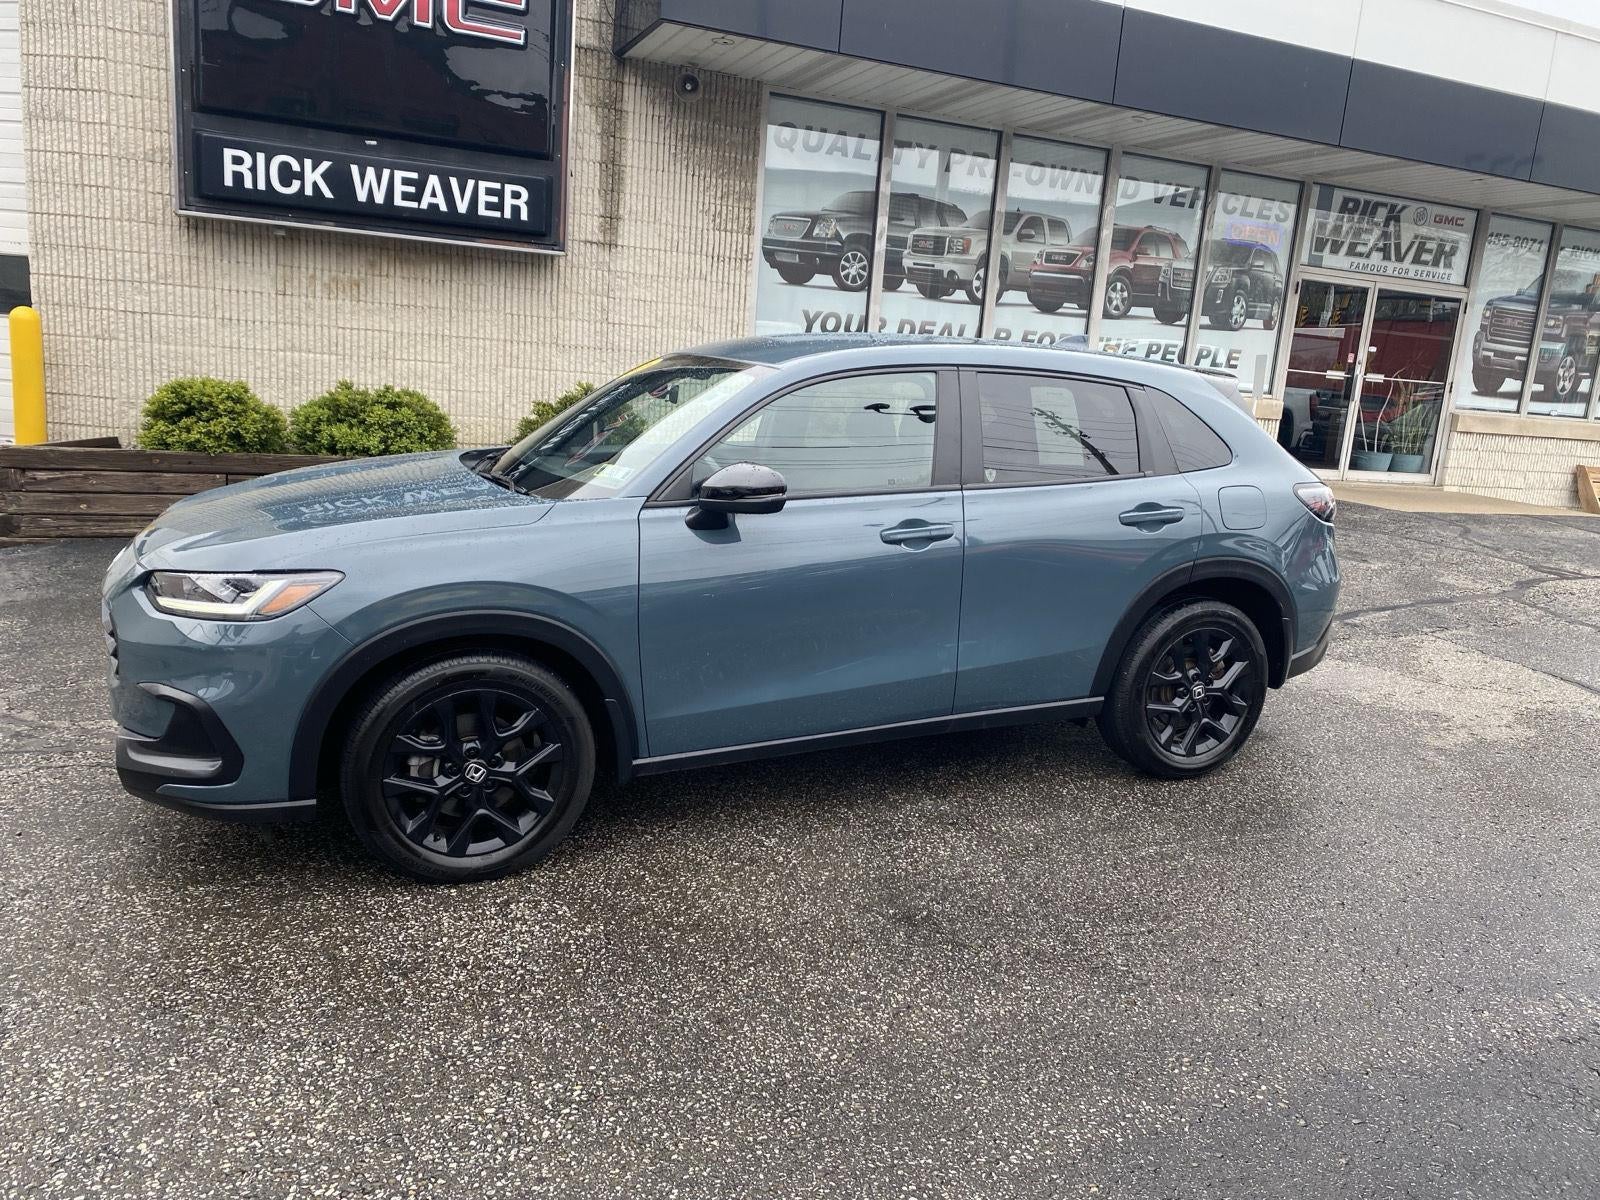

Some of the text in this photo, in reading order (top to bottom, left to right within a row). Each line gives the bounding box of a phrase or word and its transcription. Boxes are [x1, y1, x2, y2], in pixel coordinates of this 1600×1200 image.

[773, 122, 938, 169] QUALTY
[944, 147, 1141, 200] PR-OWND
[222, 147, 529, 221] RICK WEAVER
[1334, 196, 1409, 228] RICK
[1433, 213, 1465, 227] GMC
[1314, 221, 1459, 270] WEAVER
[1350, 261, 1453, 281] FAMOUS FOR SERVICE
